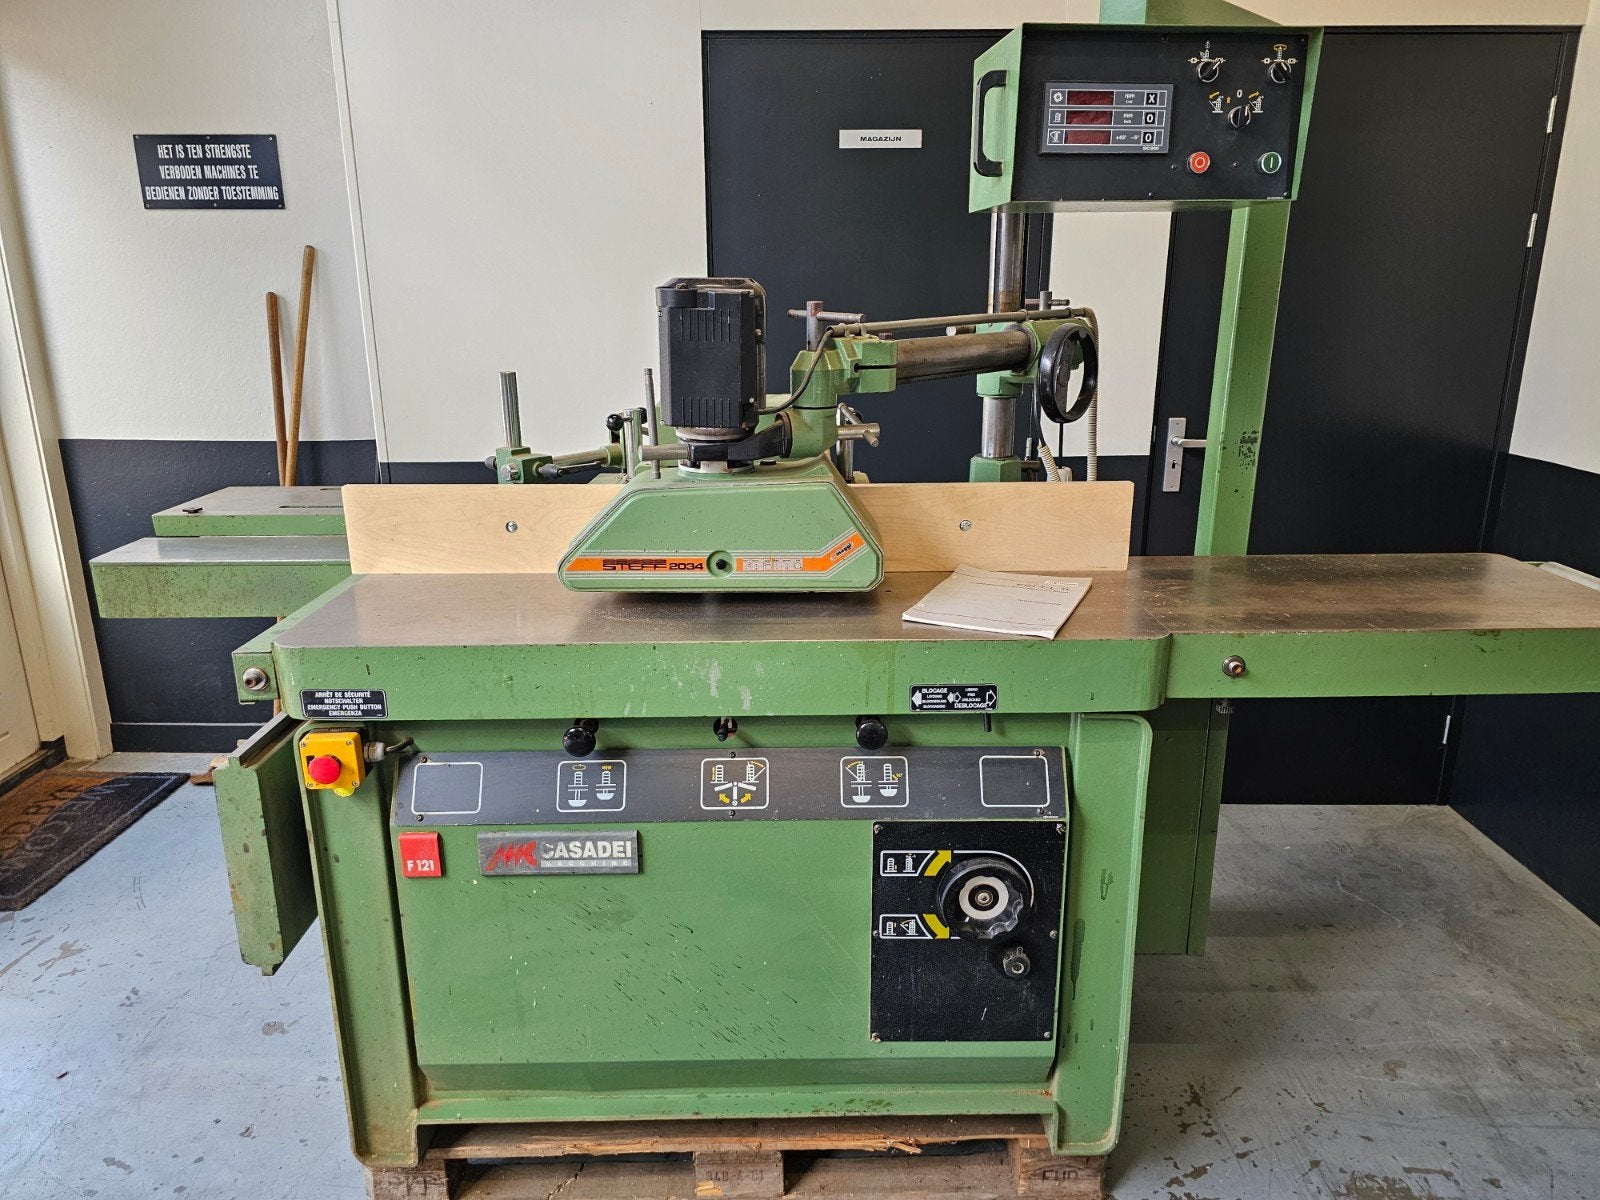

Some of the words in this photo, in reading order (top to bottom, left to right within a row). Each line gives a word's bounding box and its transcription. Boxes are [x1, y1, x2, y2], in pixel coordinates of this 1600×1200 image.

[157, 144, 172, 158] HET
[175, 144, 184, 158] IS
[186, 144, 202, 158] TEN
[205, 144, 252, 158] STRENGSTE
[159, 165, 202, 179] VERBODEN
[204, 165, 246, 179] MACHINES
[248, 165, 259, 179] TE
[145, 186, 186, 200] BEDIENEN
[187, 186, 220, 200] ZONDER
[221, 186, 279, 200] TOESTEMMING
[602, 559, 666, 570] STEFF
[540, 841, 631, 859] CASADEI
[407, 860, 413, 871] F
[416, 860, 434, 871] 121
